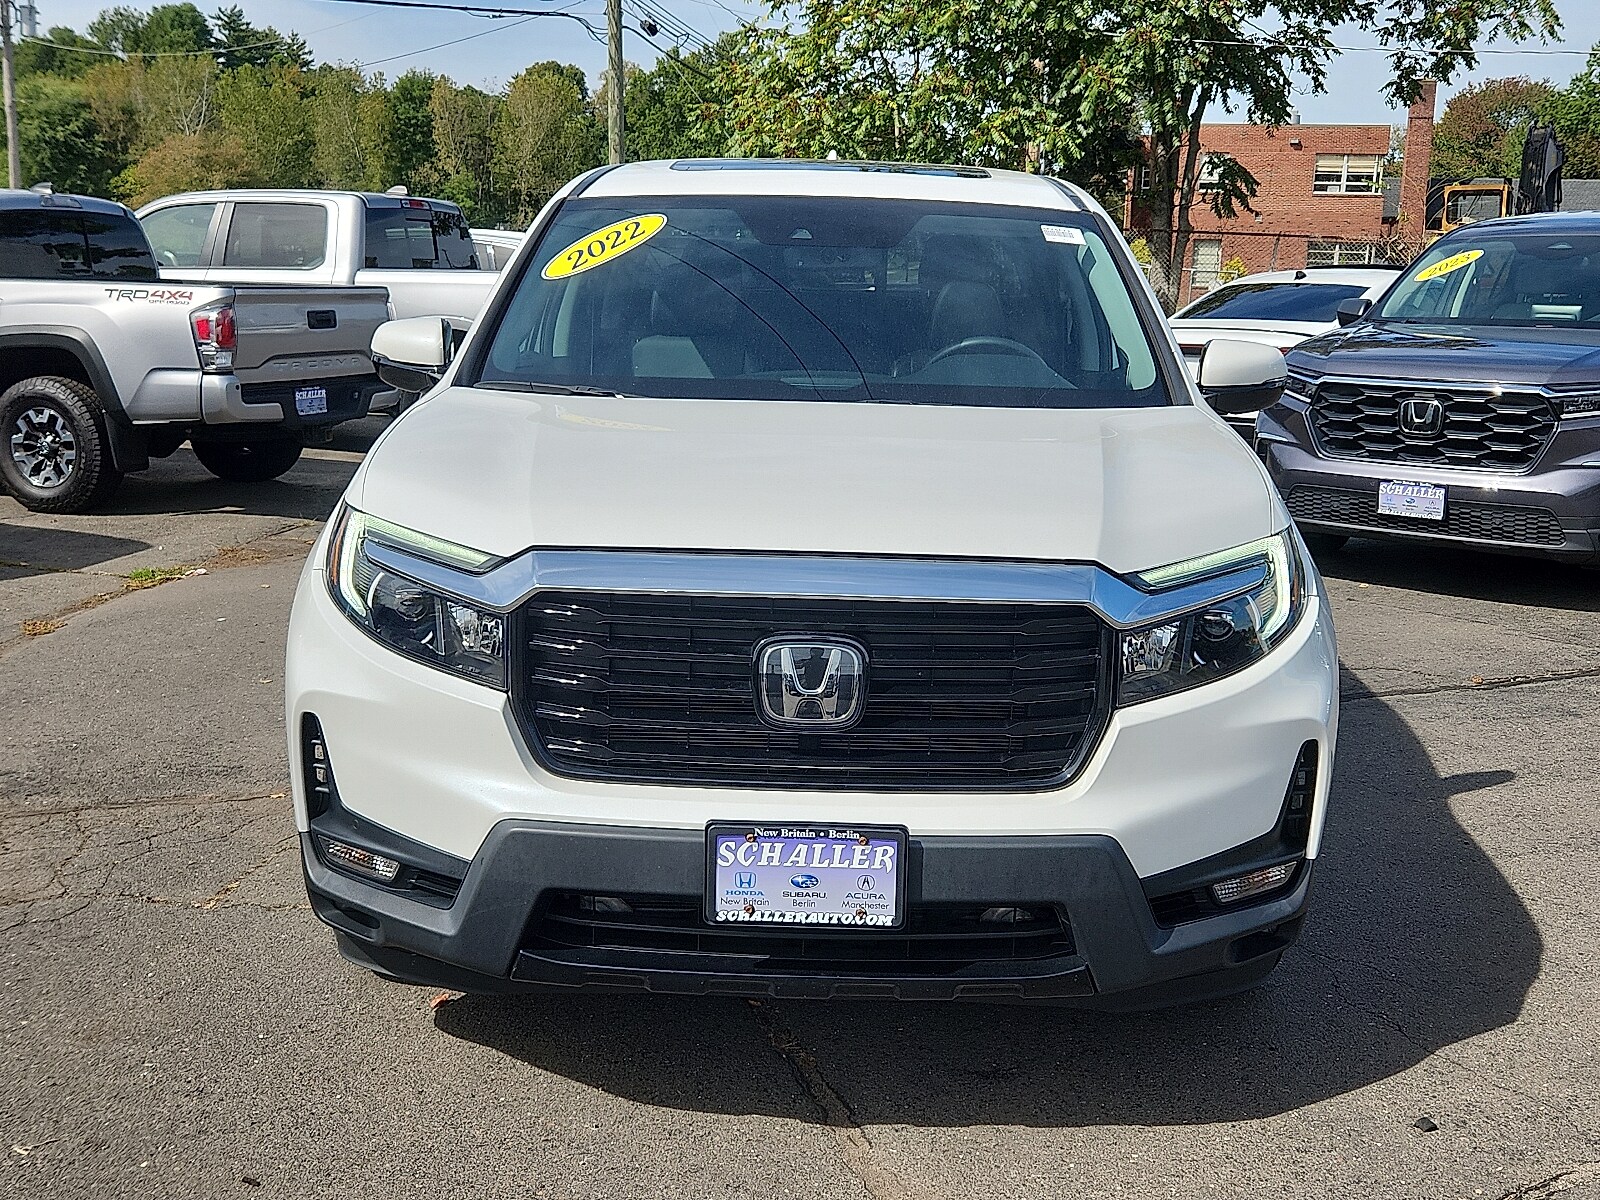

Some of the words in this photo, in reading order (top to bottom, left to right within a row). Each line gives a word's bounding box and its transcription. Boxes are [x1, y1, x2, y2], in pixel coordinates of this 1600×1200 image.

[567, 221, 646, 271] 2022
[1428, 253, 1472, 278] 2023
[295, 390, 326, 400] SCHALLER
[1379, 483, 1444, 500] SCHALLER
[754, 827, 779, 837] New
[781, 828, 816, 838] Britain
[828, 829, 860, 839] Berlin
[717, 841, 896, 874] SCHALLER
[782, 890, 826, 899] SUBARU
[845, 892, 886, 901] ACURA
[720, 897, 741, 906] New
[743, 897, 770, 906] Britain
[792, 899, 816, 908] Berlin
[841, 900, 890, 910] Manchester
[716, 910, 895, 927] SCHALLERAUTO.COM
